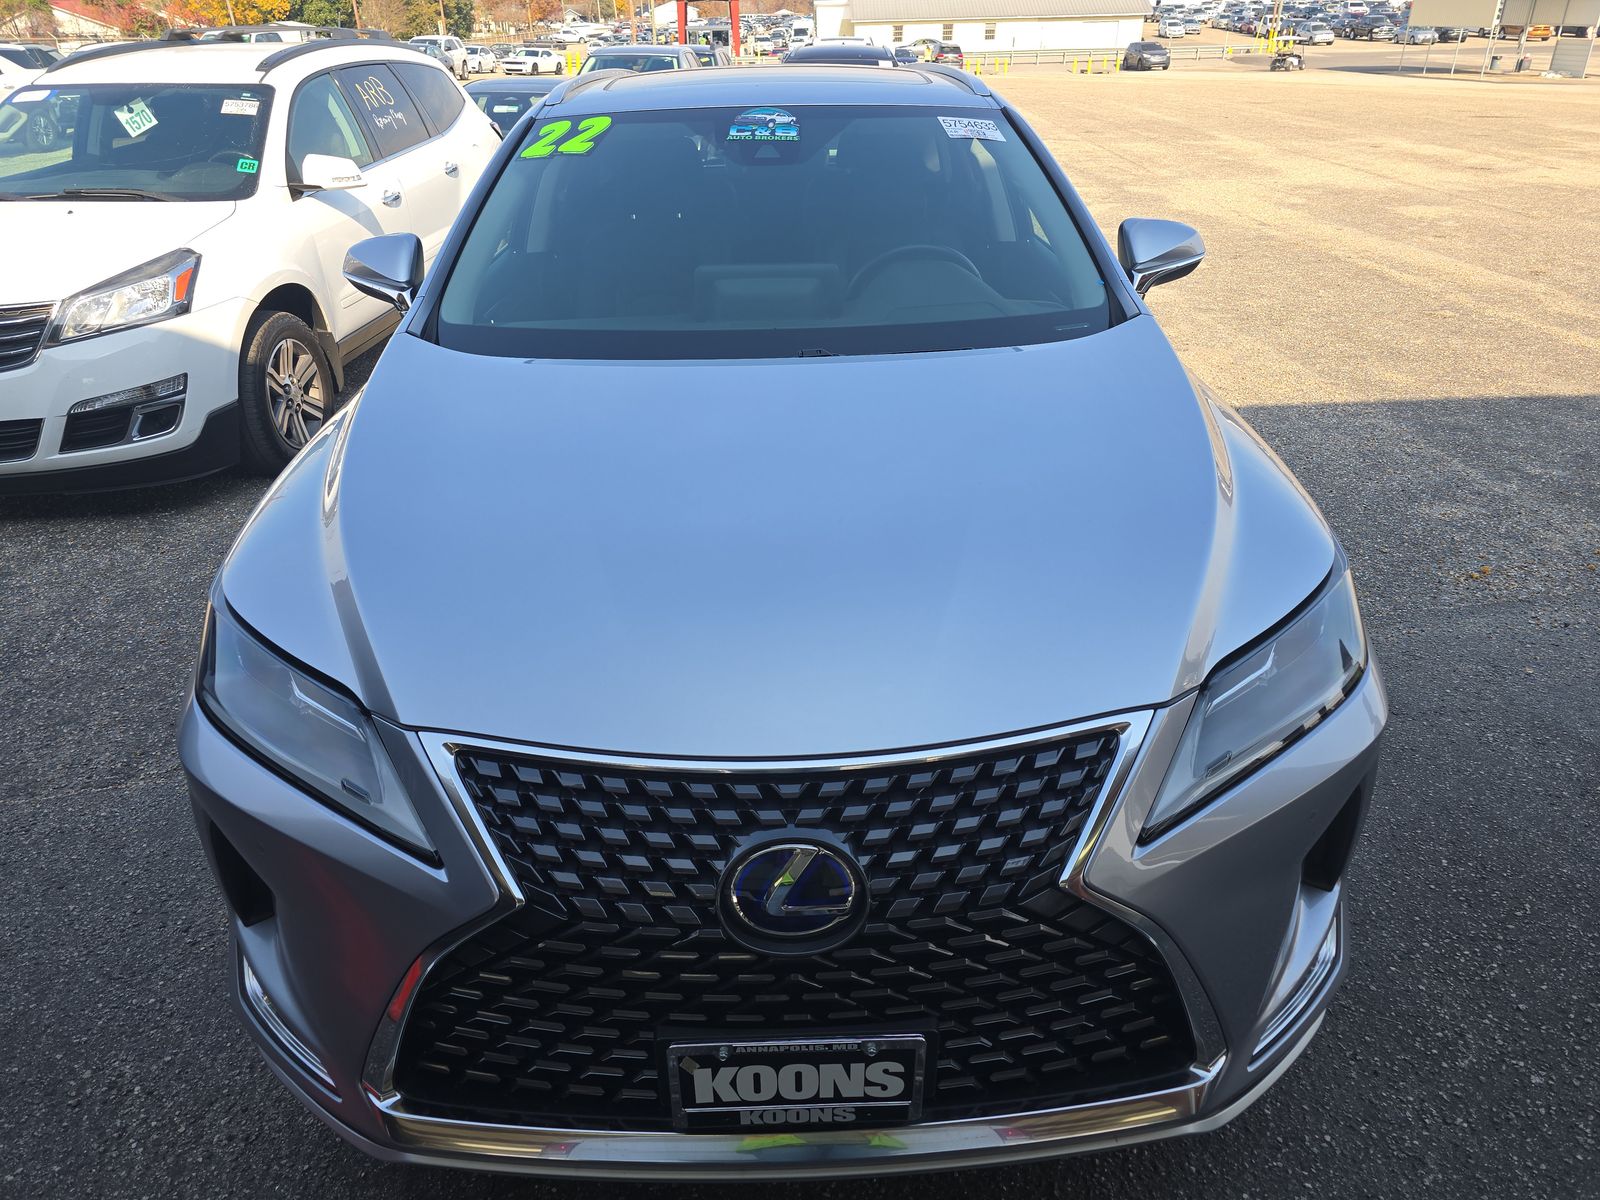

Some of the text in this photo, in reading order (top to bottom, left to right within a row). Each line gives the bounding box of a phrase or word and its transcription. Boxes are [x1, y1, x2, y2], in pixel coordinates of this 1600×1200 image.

[125, 109, 152, 133] 1570
[520, 116, 612, 159] 22
[240, 161, 256, 171] CR
[693, 1061, 905, 1104] KOONS
[739, 1107, 857, 1125] KOONS
